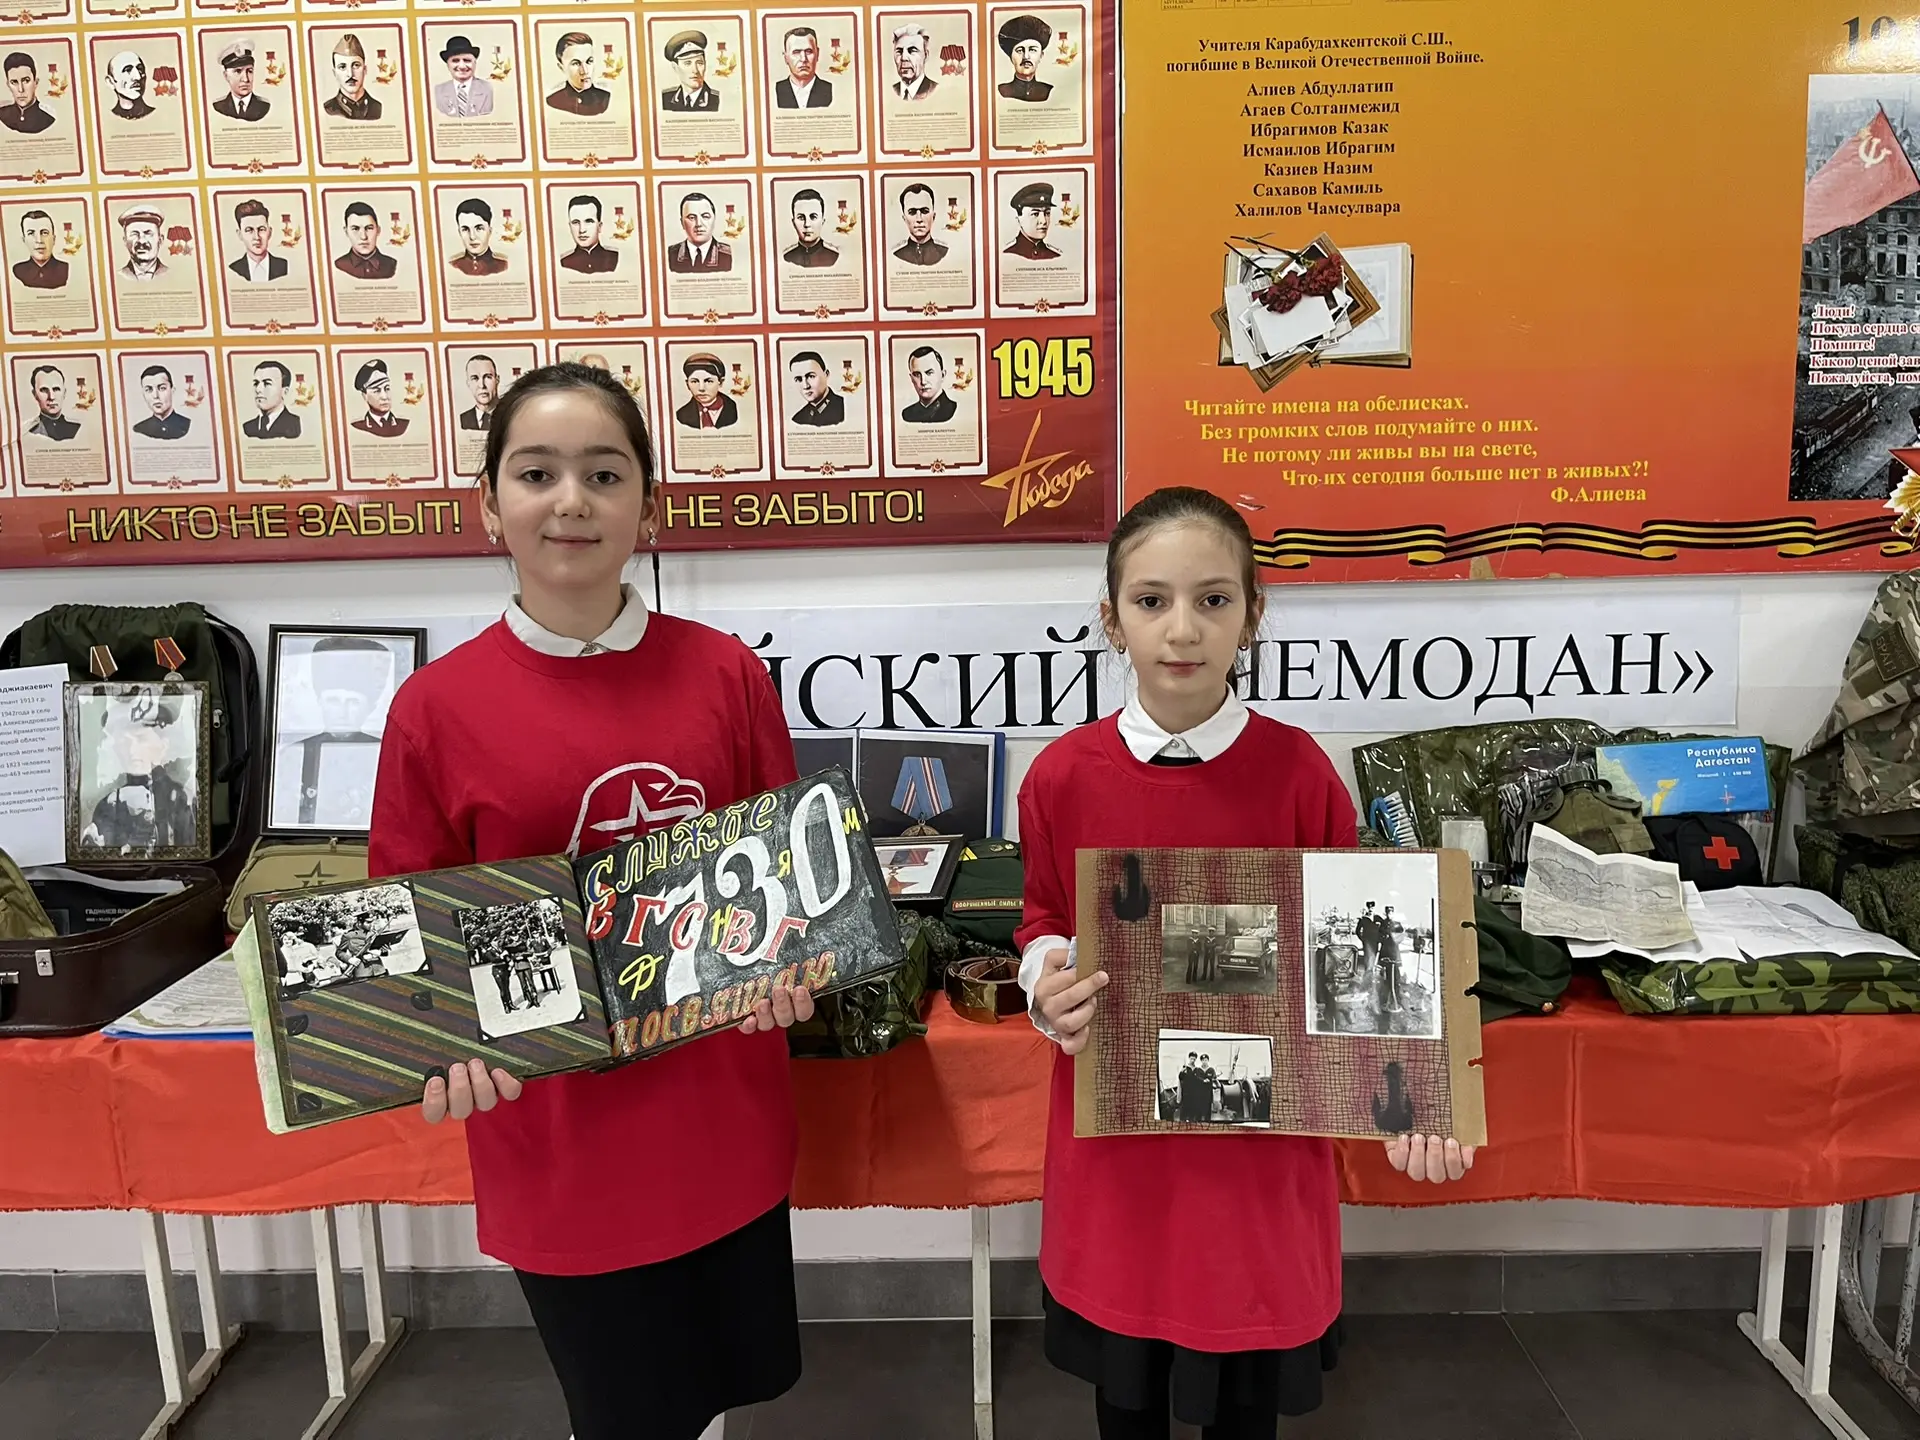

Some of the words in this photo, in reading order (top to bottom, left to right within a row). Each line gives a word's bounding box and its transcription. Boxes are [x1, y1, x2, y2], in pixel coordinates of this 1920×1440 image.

[1199, 38, 1260, 54] Учителя
[1265, 33, 1406, 53] Карабудахкентской
[1411, 32, 1453, 48] С.Ш.,
[1167, 57, 1238, 73] погибшие
[1242, 61, 1250, 70] в
[1255, 56, 1316, 70] Великой
[1321, 52, 1431, 68] Отечественной
[1436, 51, 1484, 65] Войне.
[1247, 82, 1296, 96] Алиев
[1301, 81, 1394, 98] Абдуллатип
[1240, 103, 1285, 117] Агаев
[1291, 100, 1399, 116] Солтанмежид
[1250, 122, 1337, 138] Ибрагимов
[1342, 121, 1389, 134] Казак
[1243, 143, 1320, 157] Исмаилов
[1326, 142, 1395, 157] Ибрагим
[1264, 163, 1318, 176] Казиев
[1323, 162, 1373, 175] Назим
[1253, 183, 1317, 196] Сахавов
[1322, 182, 1383, 195] Камиль
[1235, 203, 1302, 217] Халилов
[1307, 201, 1400, 216] Чамсулвара
[1812, 305, 1855, 319] Люди!
[1811, 322, 1860, 336] Покуда
[1863, 324, 1907, 336] сердца
[1810, 338, 1875, 351] Помните!
[992, 337, 1094, 400] 1945
[1810, 355, 1854, 367] Какою
[1858, 355, 1897, 368] ценой
[1808, 371, 1894, 386] Пожалуйста,
[1185, 398, 1266, 416] Читайте
[1272, 400, 1331, 414] имена
[1337, 399, 1358, 413] на
[1365, 395, 1469, 411] обелисках.
[1200, 423, 1231, 440] Без
[1238, 423, 1319, 441] громких
[1325, 422, 1368, 437] слов
[1375, 417, 1475, 437] подумайте
[1481, 420, 1493, 432] о
[1498, 416, 1538, 432] них.
[1222, 448, 1247, 464] Не
[1254, 448, 1321, 465] потому
[1327, 447, 1351, 460] ли
[1357, 444, 1412, 459] живы
[1419, 444, 1445, 458] вы
[1453, 443, 1475, 457] на
[1481, 441, 1537, 459] свете,
[1352, 468, 1424, 485] сегодня
[1430, 466, 1503, 482] больше
[1508, 465, 1541, 479] нет
[1547, 465, 1558, 478] в
[1564, 461, 1649, 478] живых?!
[1550, 486, 1646, 503] Ф.Алиева
[666, 494, 722, 529] НЕ
[733, 490, 924, 526] ЗАБЫТО!
[68, 506, 218, 543] НИКТО
[228, 504, 288, 538] НЕ
[298, 501, 462, 538] ЗАБЫТ!
[1687, 746, 1756, 758] Республика
[1695, 757, 1750, 768] Дагестан
